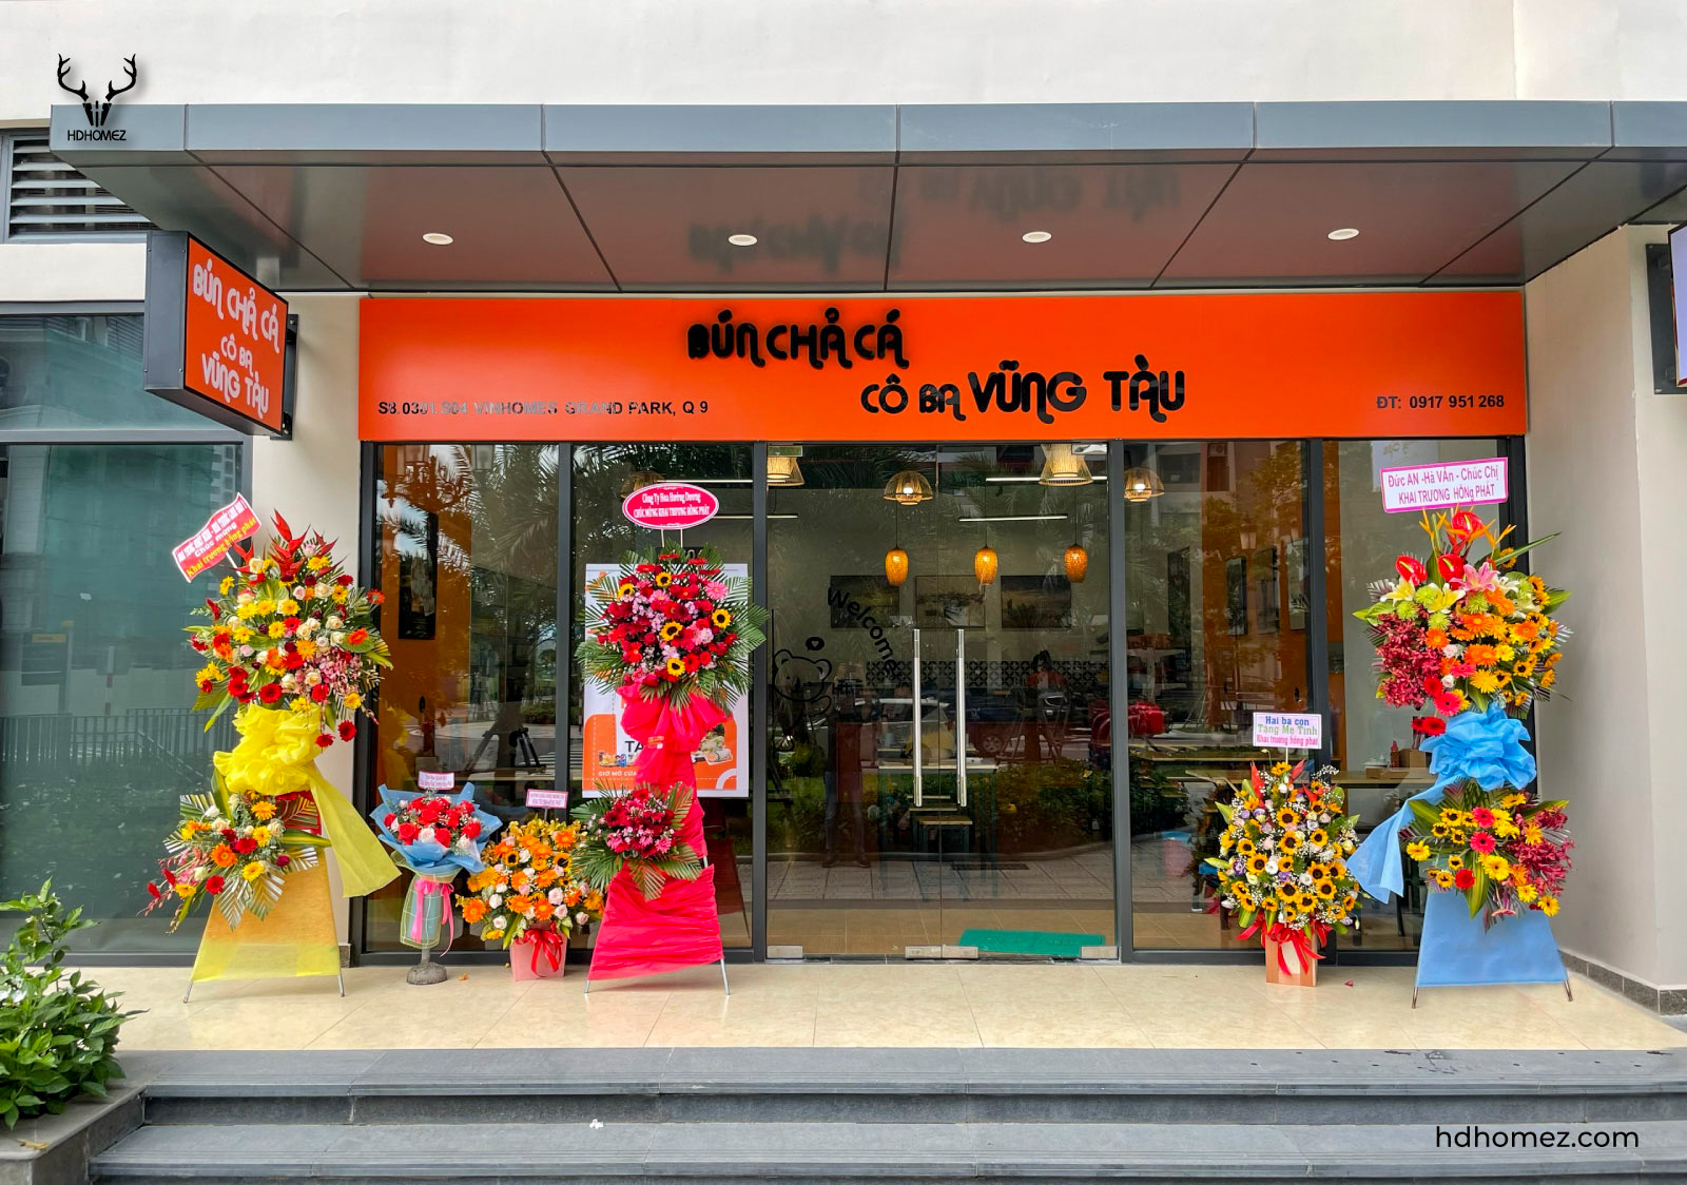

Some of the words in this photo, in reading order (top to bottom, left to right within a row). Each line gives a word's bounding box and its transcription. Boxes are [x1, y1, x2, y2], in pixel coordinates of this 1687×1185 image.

[193, 258, 224, 320] BÚN
[227, 287, 258, 340] CHẢ
[261, 303, 280, 354] CÁ
[221, 333, 237, 361] CÔ
[239, 346, 253, 377] BA
[688, 309, 766, 368] BÚN
[766, 307, 853, 370] CHẢ
[854, 308, 910, 370] CÁ
[202, 351, 240, 403] VŨNG
[244, 371, 269, 419] TÀU
[861, 373, 909, 414] CÔ
[919, 384, 966, 422] BA
[968, 360, 1087, 424] VŨNG
[1103, 354, 1185, 423] TÀU
[1376, 396, 1401, 409] ĐT:
[1409, 396, 1443, 408] 0917
[1448, 395, 1474, 408] 951
[1478, 395, 1504, 408] 268
[474, 402, 557, 414] VINHOMES
[565, 402, 623, 414] GRAND
[628, 401, 676, 416] PARK,
[1388, 471, 1405, 487] Đức
[1407, 472, 1419, 485] AN
[1460, 467, 1482, 481] Chúc
[1484, 465, 1499, 481] Chị
[1398, 491, 1416, 505] KHAI
[1475, 481, 1495, 497] PHÁT
[186, 561, 203, 577] Khai
[827, 584, 899, 678] Welcome
[1265, 716, 1279, 725] Hai
[1282, 717, 1292, 725] ba
